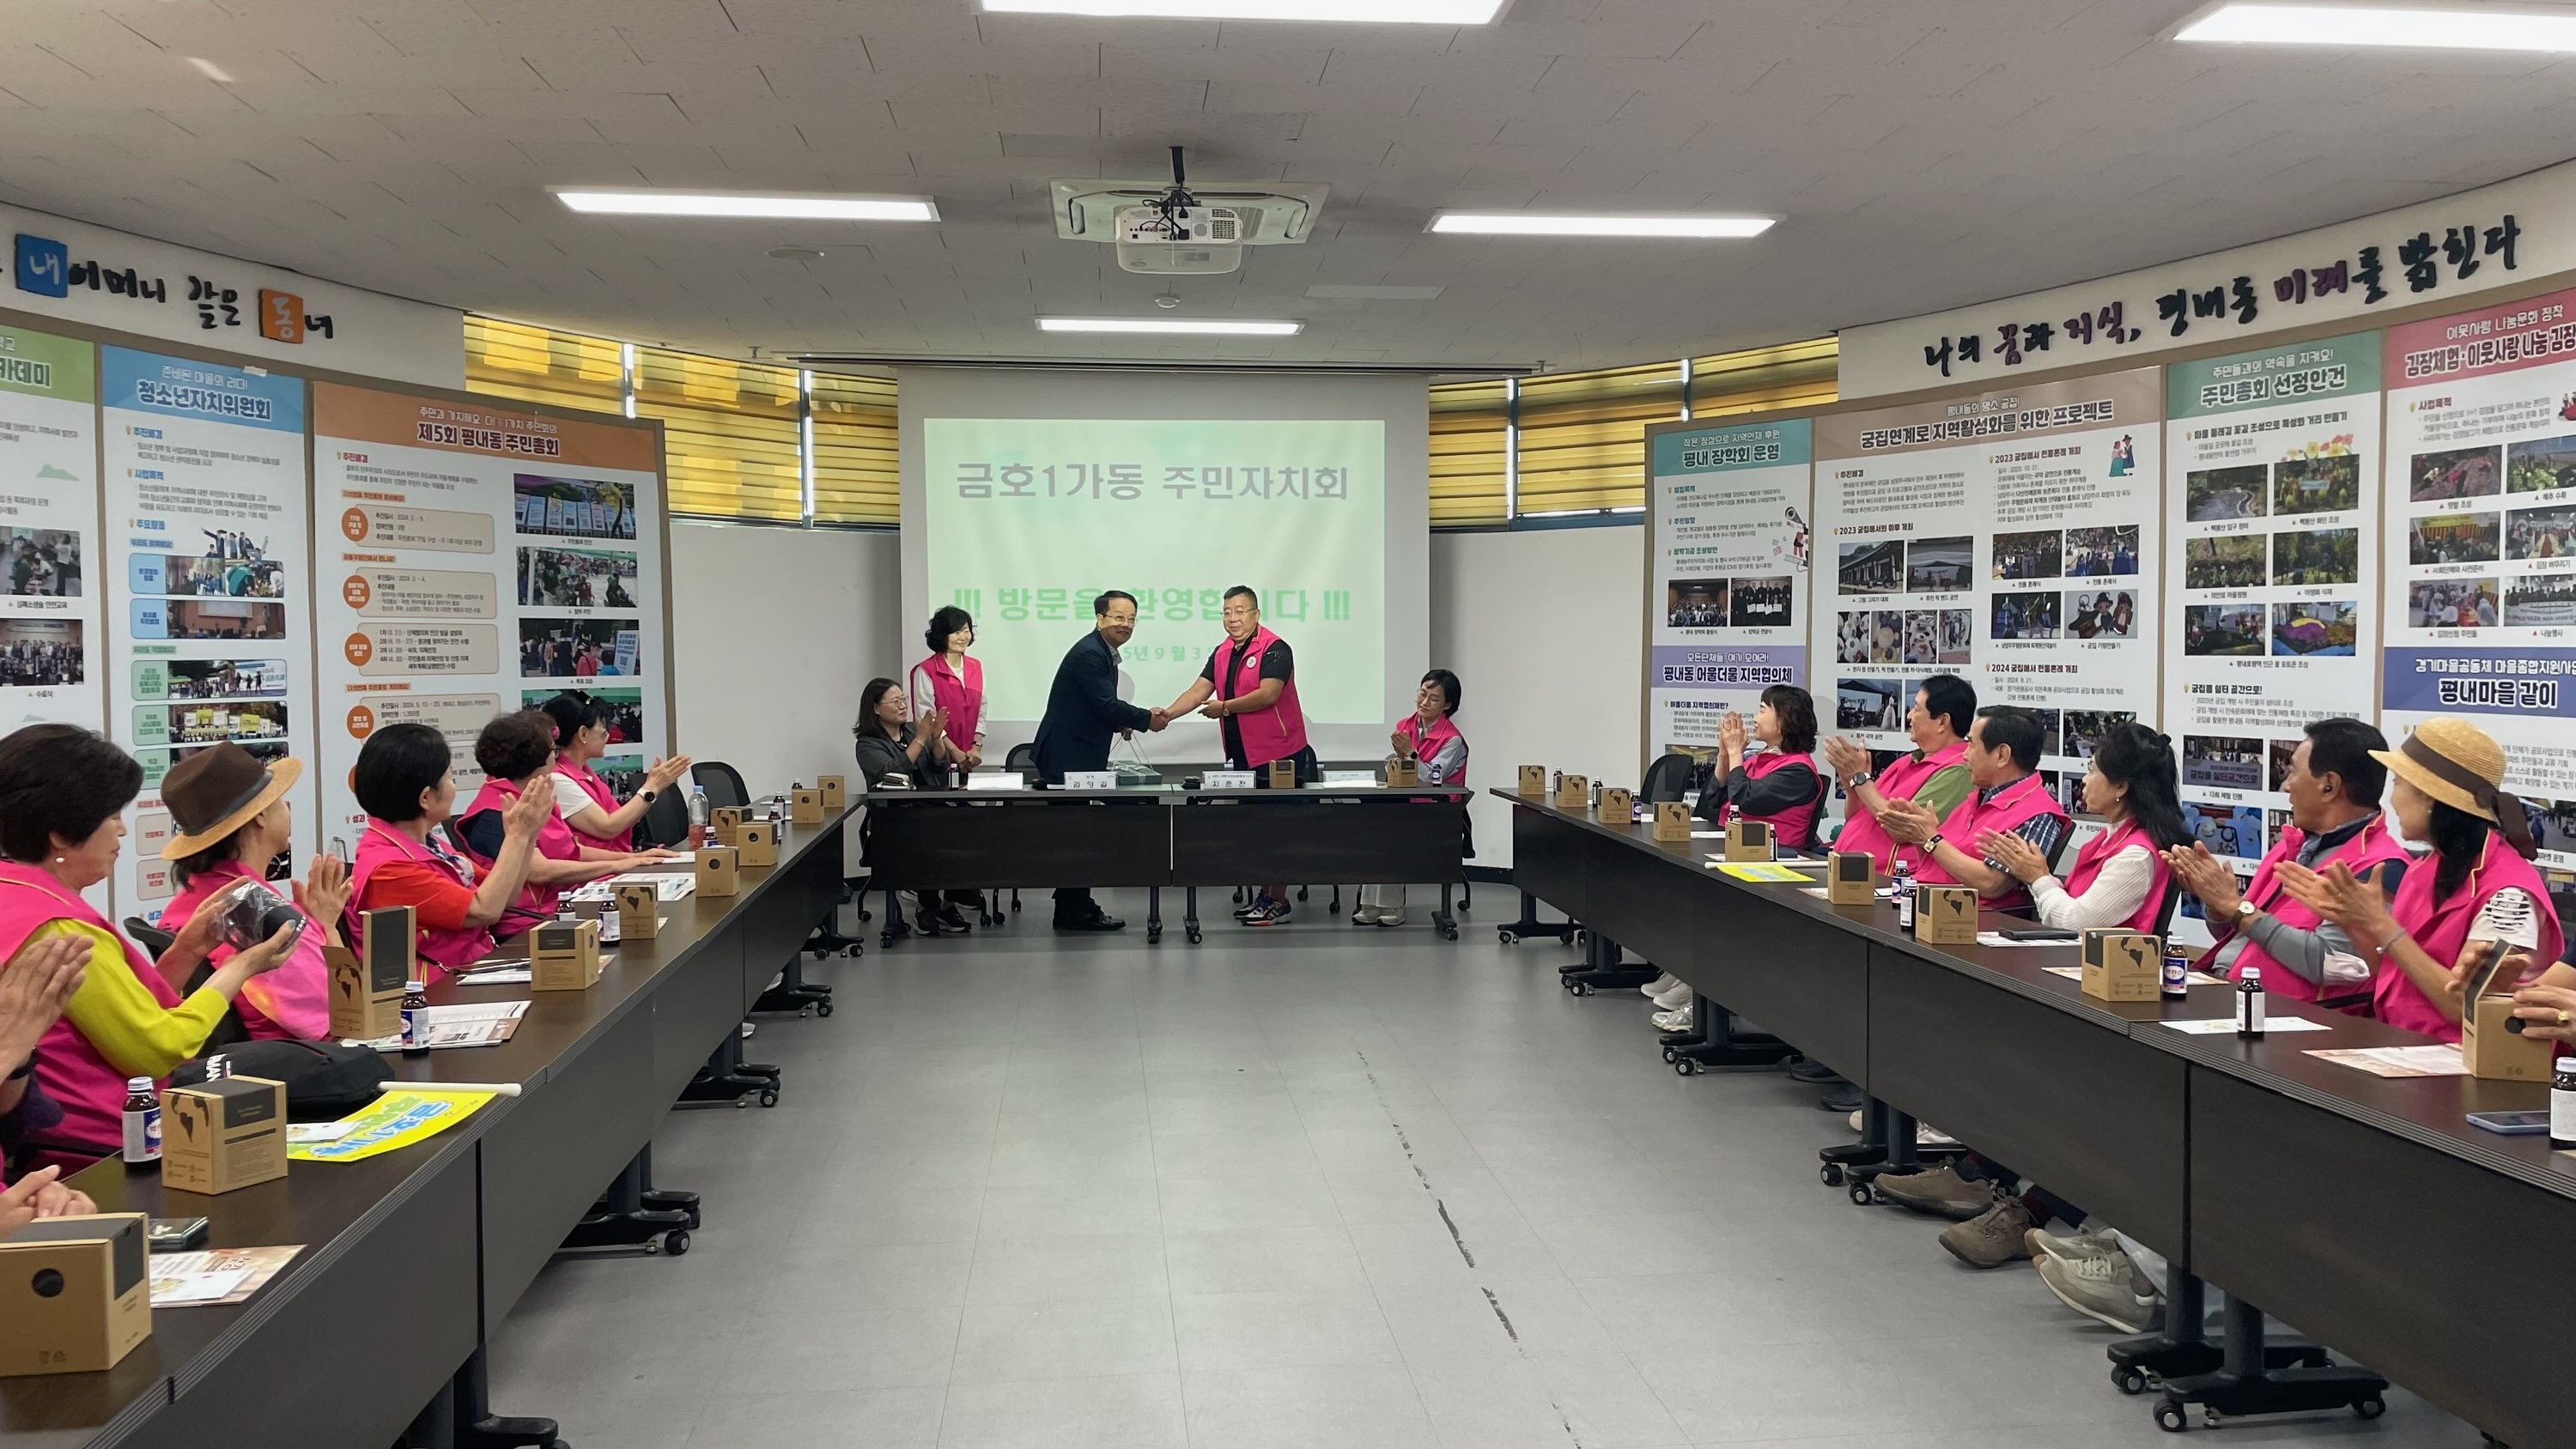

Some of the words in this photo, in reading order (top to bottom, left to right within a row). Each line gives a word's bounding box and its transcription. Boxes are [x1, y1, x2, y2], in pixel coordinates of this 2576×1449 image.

[2273, 246, 2387, 305] 미래를
[2446, 320, 2491, 340] 이웃사랑
[2495, 310, 2537, 330] 나눔문화
[2542, 304, 2564, 322] 정착
[2522, 330, 2548, 358] 나눔
[2265, 355, 2295, 368] 약속을
[2299, 349, 2335, 365] 지켜요!
[161, 366, 191, 382] 준비된
[194, 371, 223, 386] 마을의
[2201, 377, 2269, 407] 주민총회
[2274, 363, 2346, 397] 선정안건
[137, 379, 272, 421] 청소년자치위원회
[2418, 397, 2452, 410] 사업목적
[1861, 424, 1930, 450] 궁집연계로
[1932, 412, 2017, 440] 지역활성화를
[2020, 409, 2050, 430] 위한
[2052, 399, 2113, 427] 프로젝트
[2251, 421, 2281, 433] 조성으로
[2306, 415, 2323, 425] 거리
[2324, 411, 2348, 423] 만들기
[417, 421, 458, 445] 제5회
[460, 427, 502, 451] 평내동
[505, 433, 560, 458] 주민총회
[1732, 430, 1763, 443] 지역인재
[1765, 428, 1781, 440] 후원
[1683, 450, 1709, 469] 평내
[1711, 446, 1751, 466] 장학회
[1753, 443, 1781, 462] 운영
[1995, 454, 2014, 464] 2023
[957, 463, 1145, 500] 금호1가동
[1162, 466, 1349, 500] 주민자치회
[999, 587, 1100, 621] 방문을
[1728, 652, 1743, 662] 여기
[1745, 652, 1770, 663] 모여라!
[1991, 664, 2009, 672] 2024
[2011, 664, 2037, 673] 궁집에서
[2415, 658, 2491, 674] 경기마을공동체
[1663, 664, 1694, 682] 평내동
[1697, 665, 1738, 683] 어울더울
[1740, 666, 1793, 684] 지역협의체
[2191, 685, 2213, 694] 궁집을
[2231, 685, 2263, 694] 공간으로!
[2439, 678, 2517, 706] 평내마을
[2518, 679, 2558, 708] 같이
